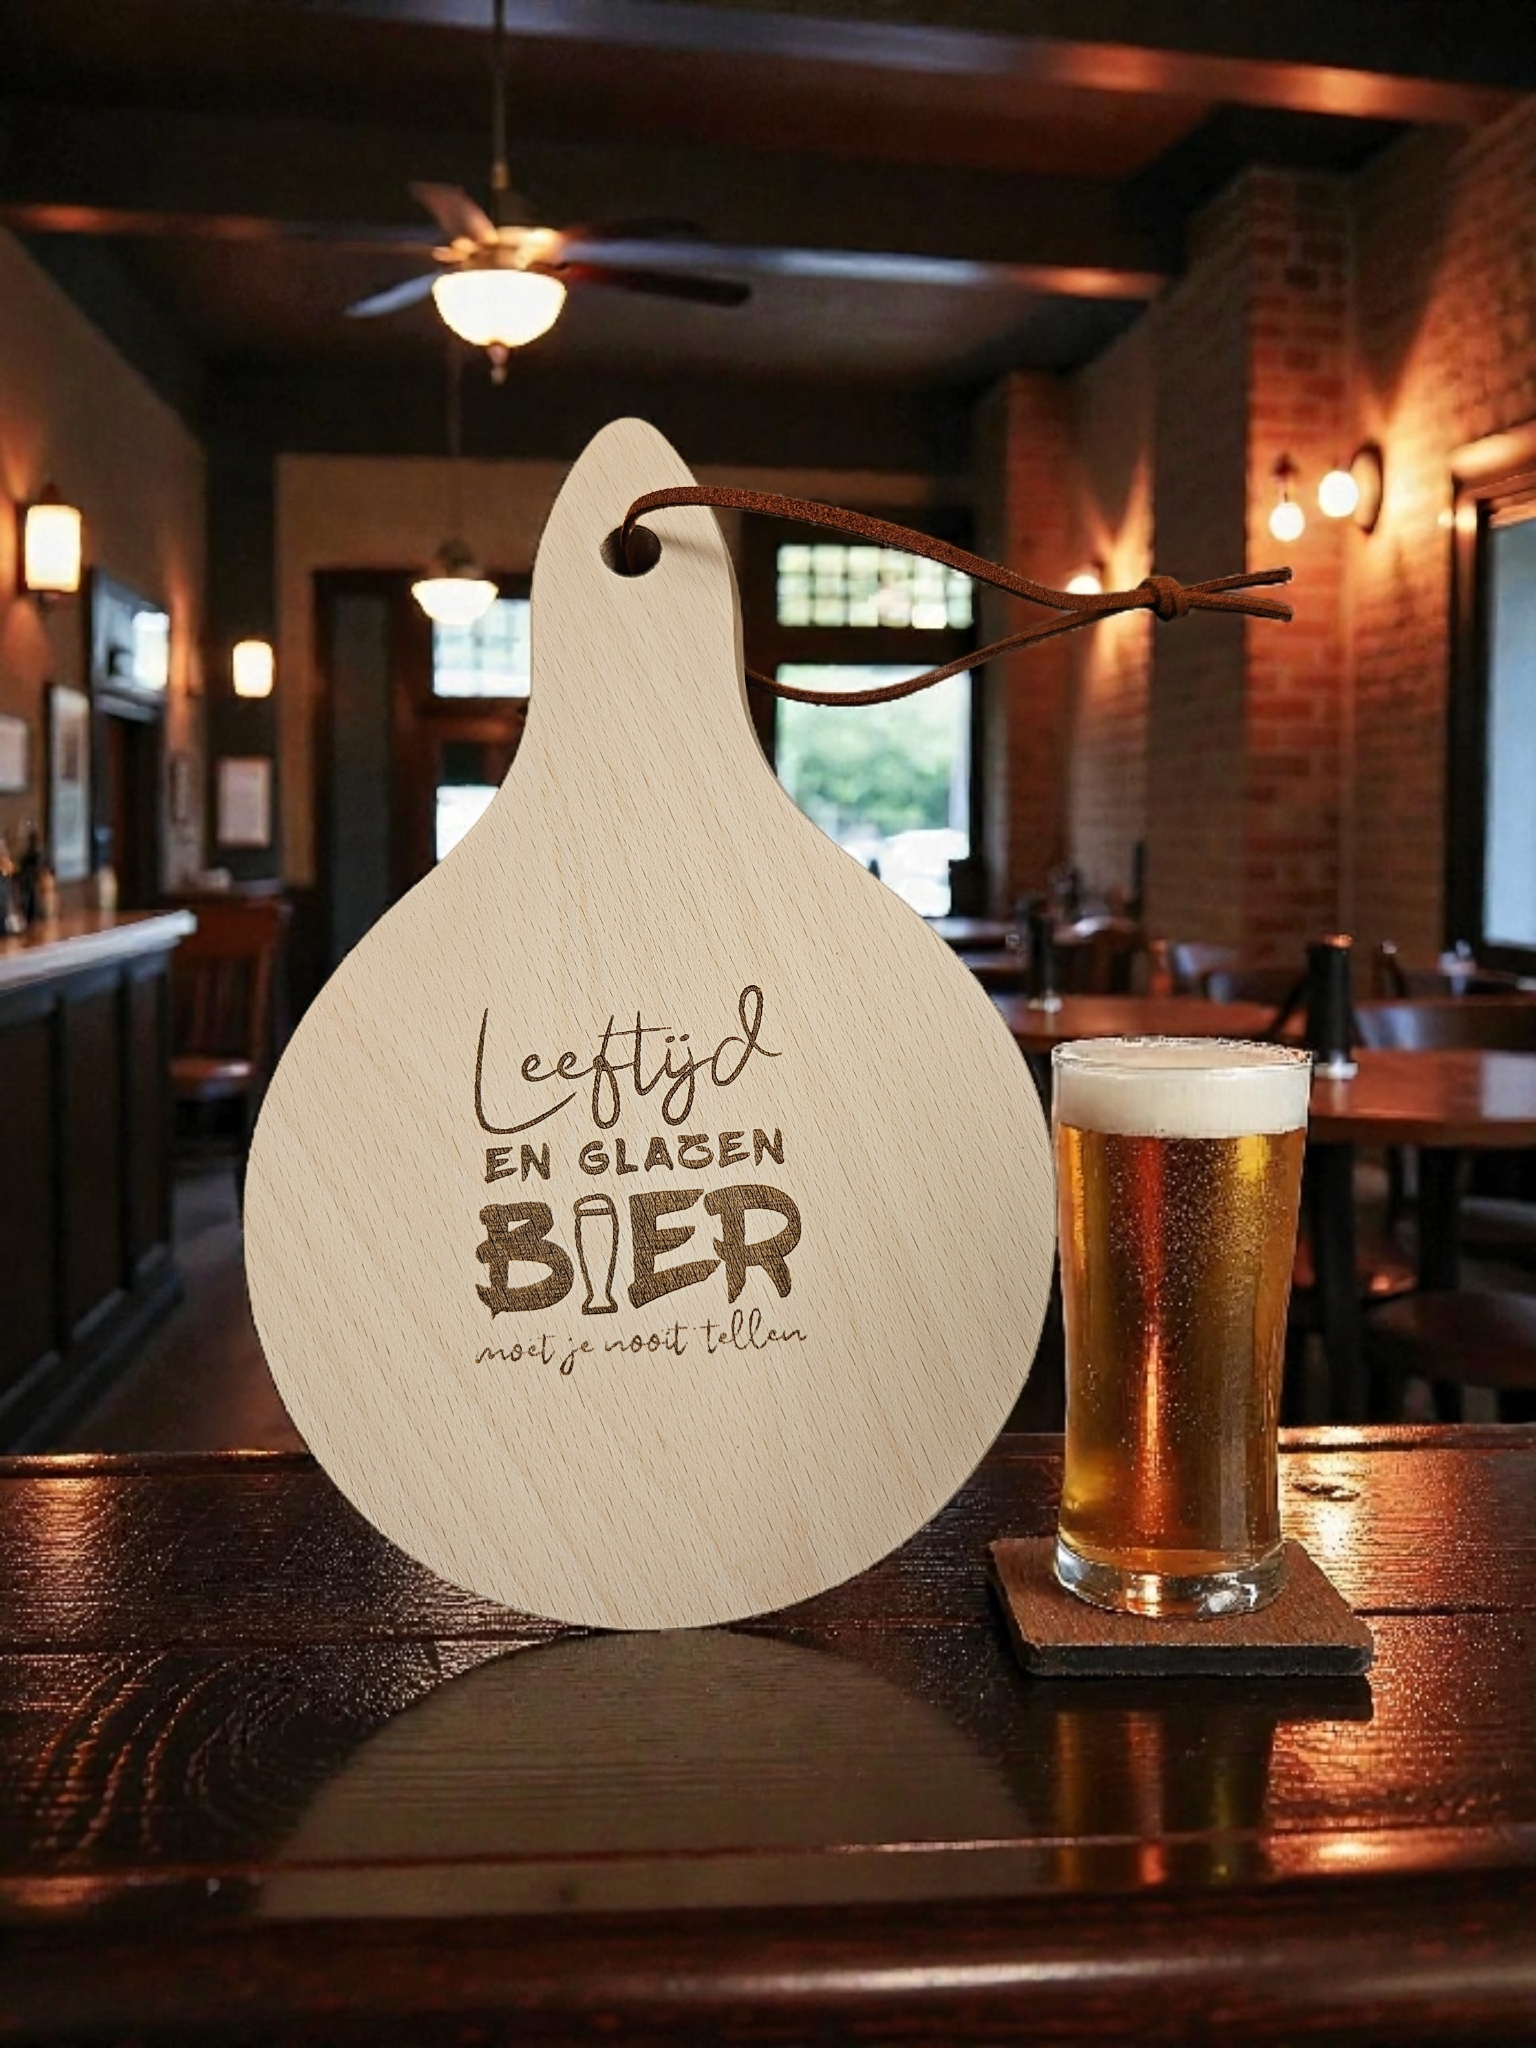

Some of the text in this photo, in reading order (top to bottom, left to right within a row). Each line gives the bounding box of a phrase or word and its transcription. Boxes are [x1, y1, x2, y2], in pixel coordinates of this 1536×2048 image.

[474, 984, 783, 1135] Leeftijd
[484, 1142, 552, 1184] EN
[475, 1307, 809, 1376] moet je nooit tellen
